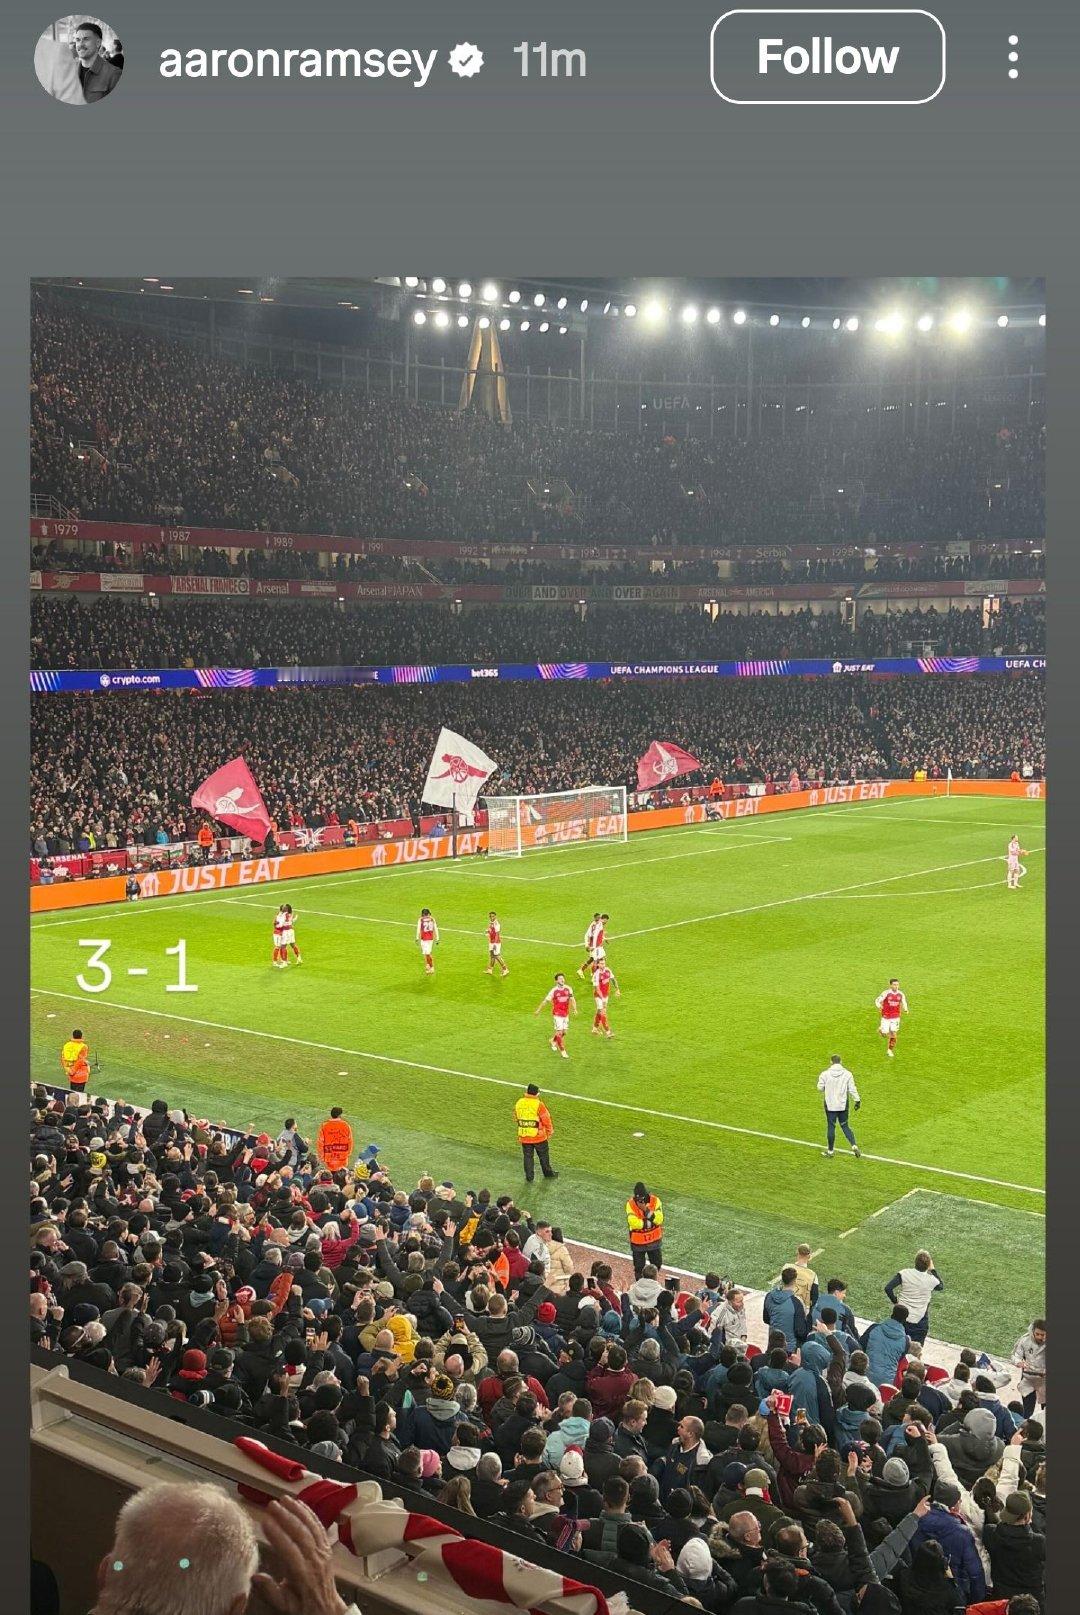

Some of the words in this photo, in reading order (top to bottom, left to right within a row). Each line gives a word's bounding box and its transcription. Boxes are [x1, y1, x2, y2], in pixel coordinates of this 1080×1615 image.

[653, 396, 690, 410] UEFA
[54, 524, 78, 536] 1979
[169, 531, 191, 541] 1987
[274, 536, 294, 548] 1989
[176, 577, 209, 592] ARSENAL
[256, 582, 290, 595] Arsenal
[357, 584, 387, 597] Arsenal
[534, 586, 557, 599] AND
[615, 587, 641, 599] OVER
[610, 665, 632, 675] UEFA
[634, 665, 683, 674] CHAMPIONS
[684, 665, 719, 674] LEAGUE
[843, 664, 859, 673] JUST
[861, 664, 874, 672] EAT
[1005, 660, 1030, 669] UEFA
[471, 668, 498, 678] bet365
[112, 674, 161, 685] crypto.com
[821, 785, 855, 804] JUST
[859, 782, 890, 799] EAT
[736, 797, 762, 816] EAT
[394, 837, 443, 863] JUST
[50, 853, 87, 863] ARSENAL
[169, 863, 233, 894] JUST
[239, 857, 285, 884] EAT
